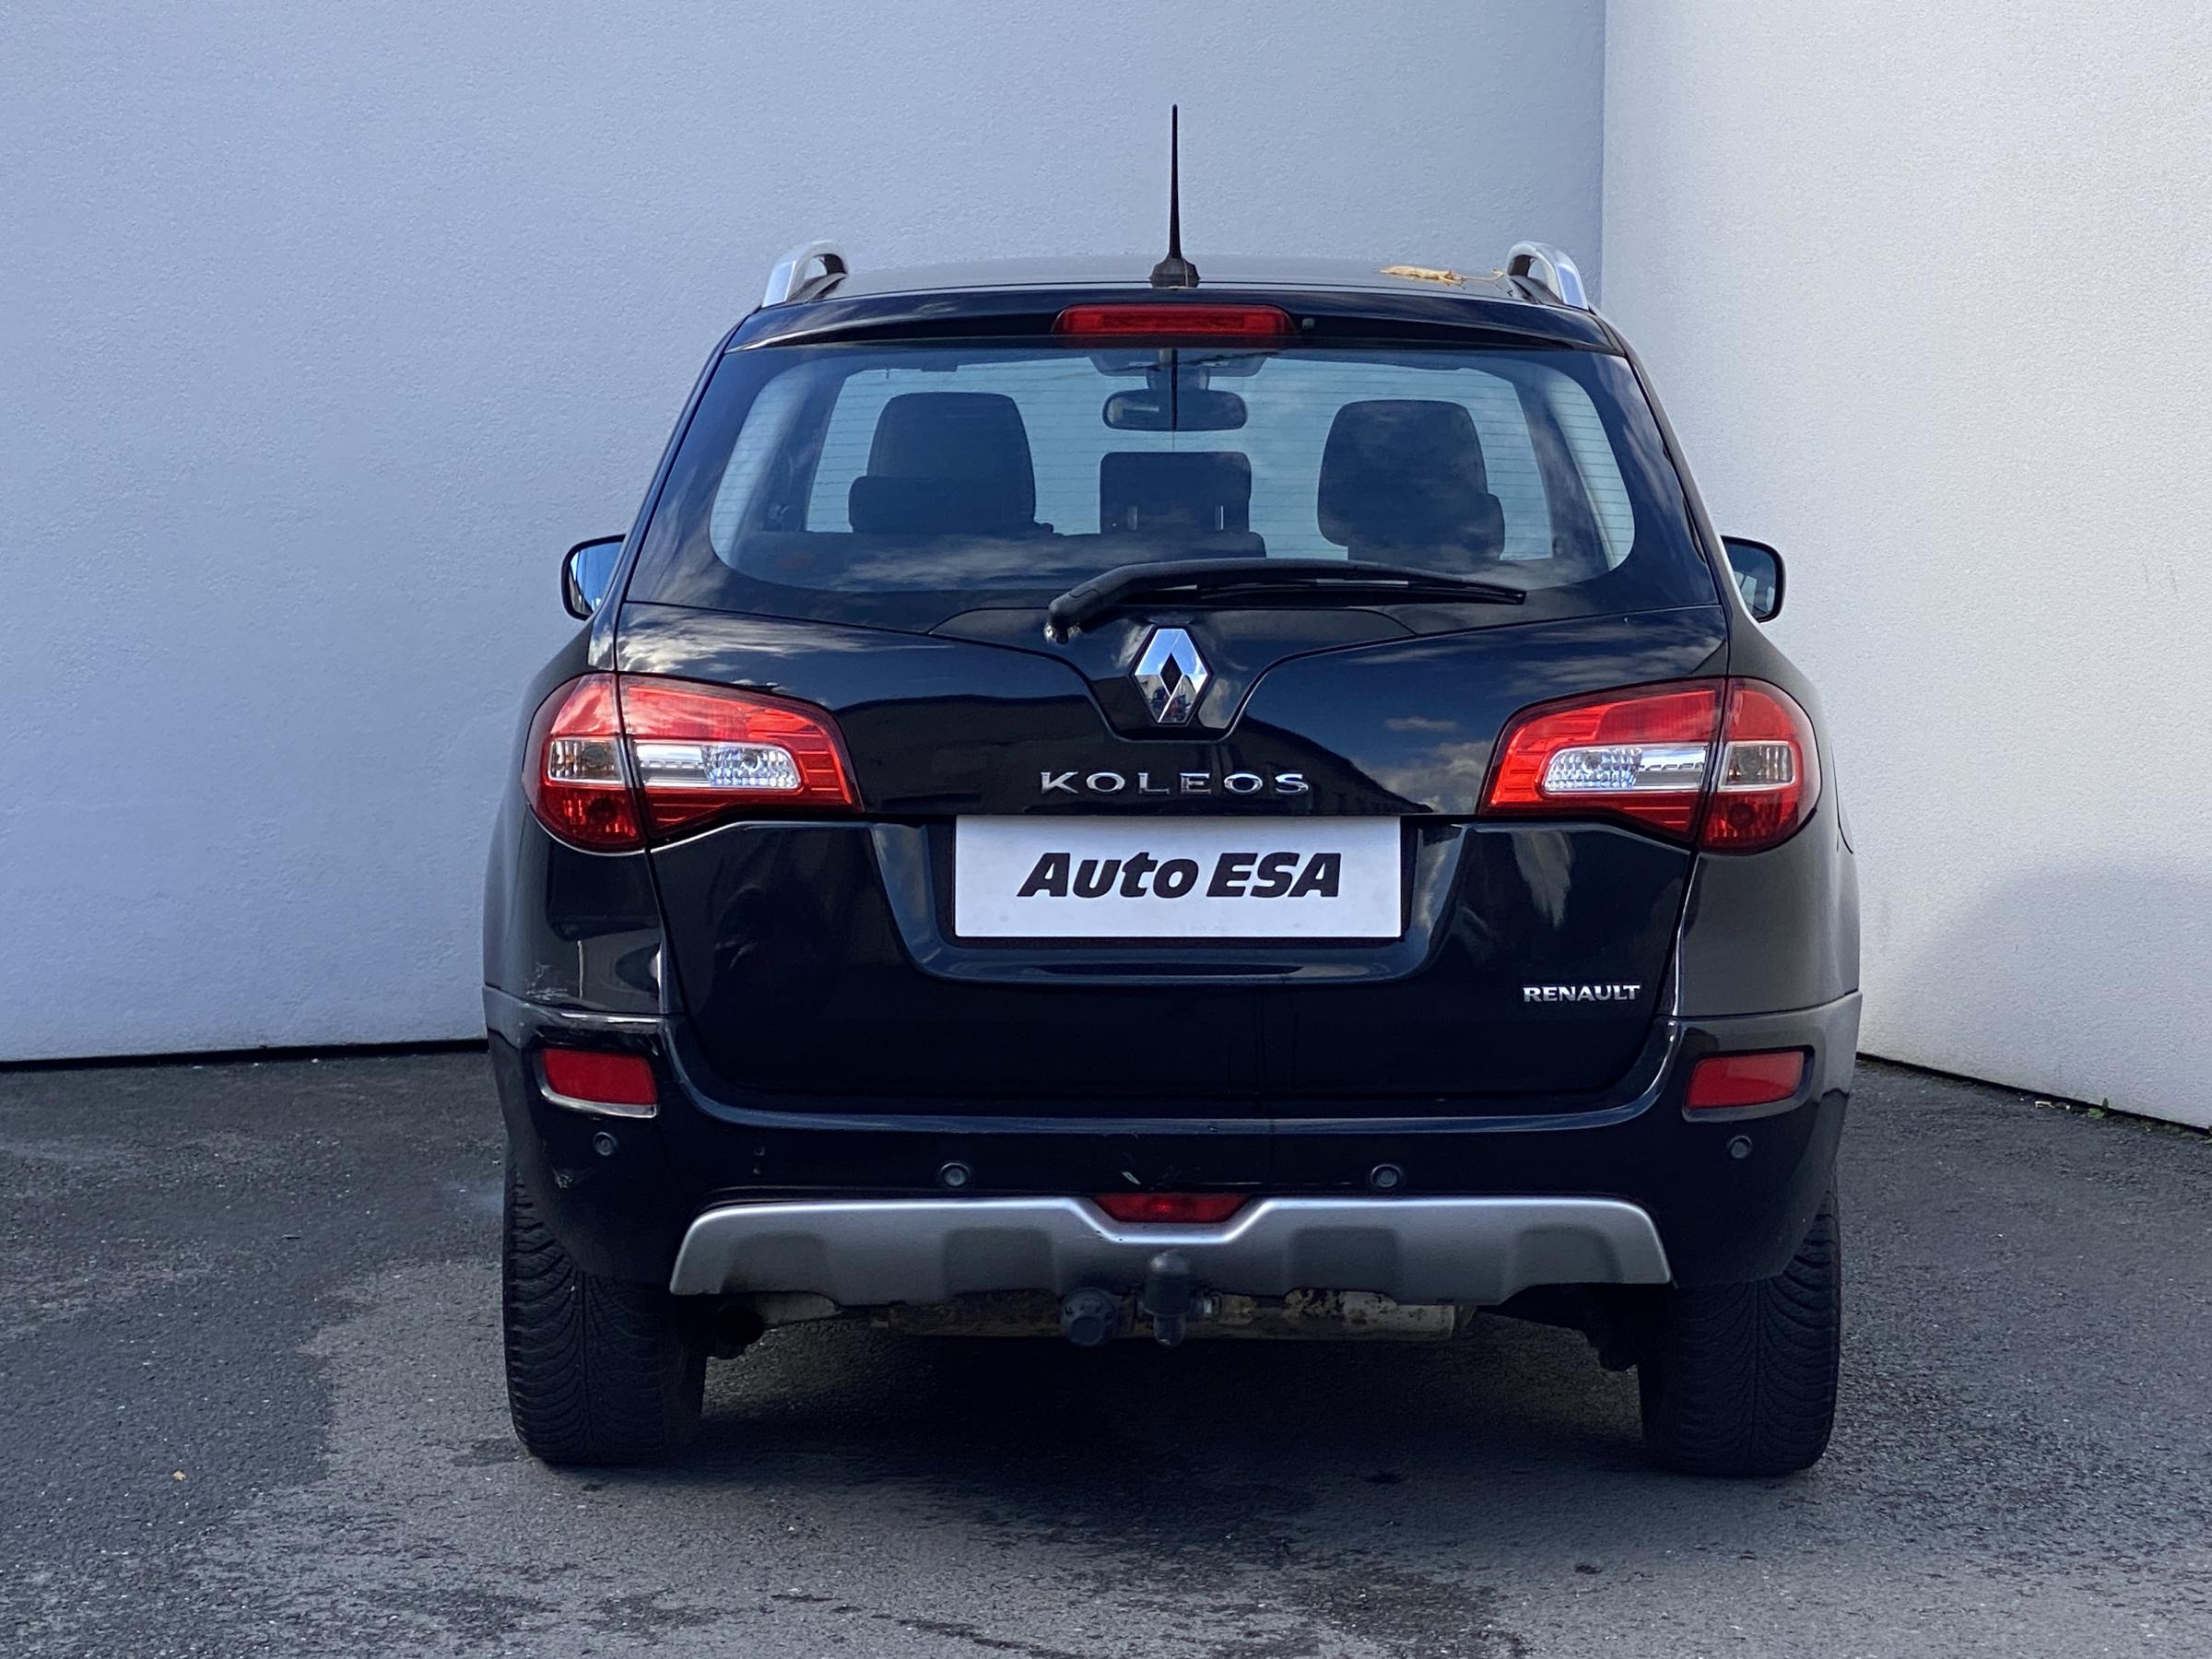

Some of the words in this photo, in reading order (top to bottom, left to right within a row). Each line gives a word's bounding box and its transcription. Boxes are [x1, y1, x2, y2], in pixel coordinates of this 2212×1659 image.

[1039, 771, 1312, 796] KOLEOS
[1016, 852, 1199, 900] Auto
[1205, 852, 1342, 900] ESA
[1522, 984, 1641, 1003] RENAULT
